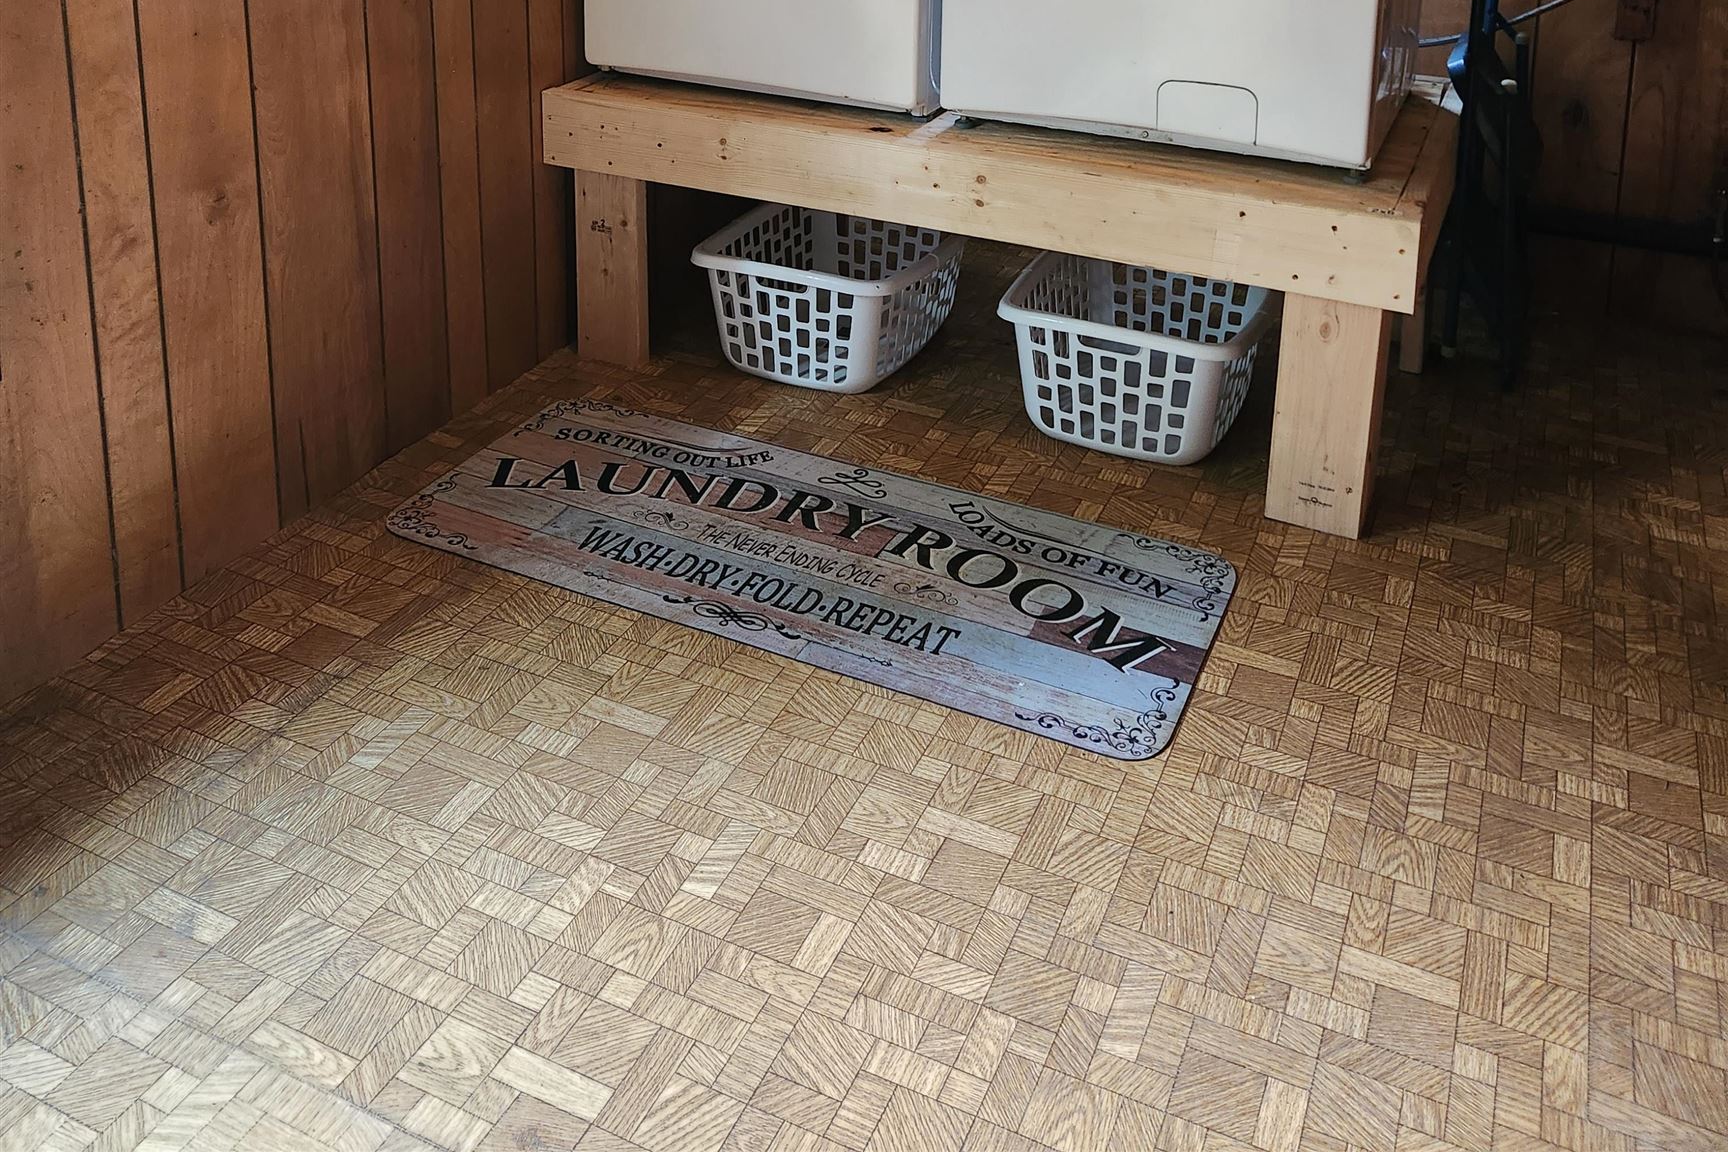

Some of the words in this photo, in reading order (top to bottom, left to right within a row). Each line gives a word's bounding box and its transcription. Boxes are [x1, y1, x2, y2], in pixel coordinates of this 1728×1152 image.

[554, 428, 670, 458] SORTING
[673, 450, 721, 467] OUT
[725, 450, 774, 467] LIFE
[485, 456, 894, 543] LAUNDRY
[887, 522, 1175, 675] ROOM
[696, 523, 730, 545] THE
[725, 532, 777, 558] NEVER
[773, 544, 838, 575] ENDING
[835, 563, 886, 588] CYCLE
[949, 501, 1037, 554] LOADS
[1041, 547, 1091, 569] OF
[1094, 559, 1178, 598] FUN
